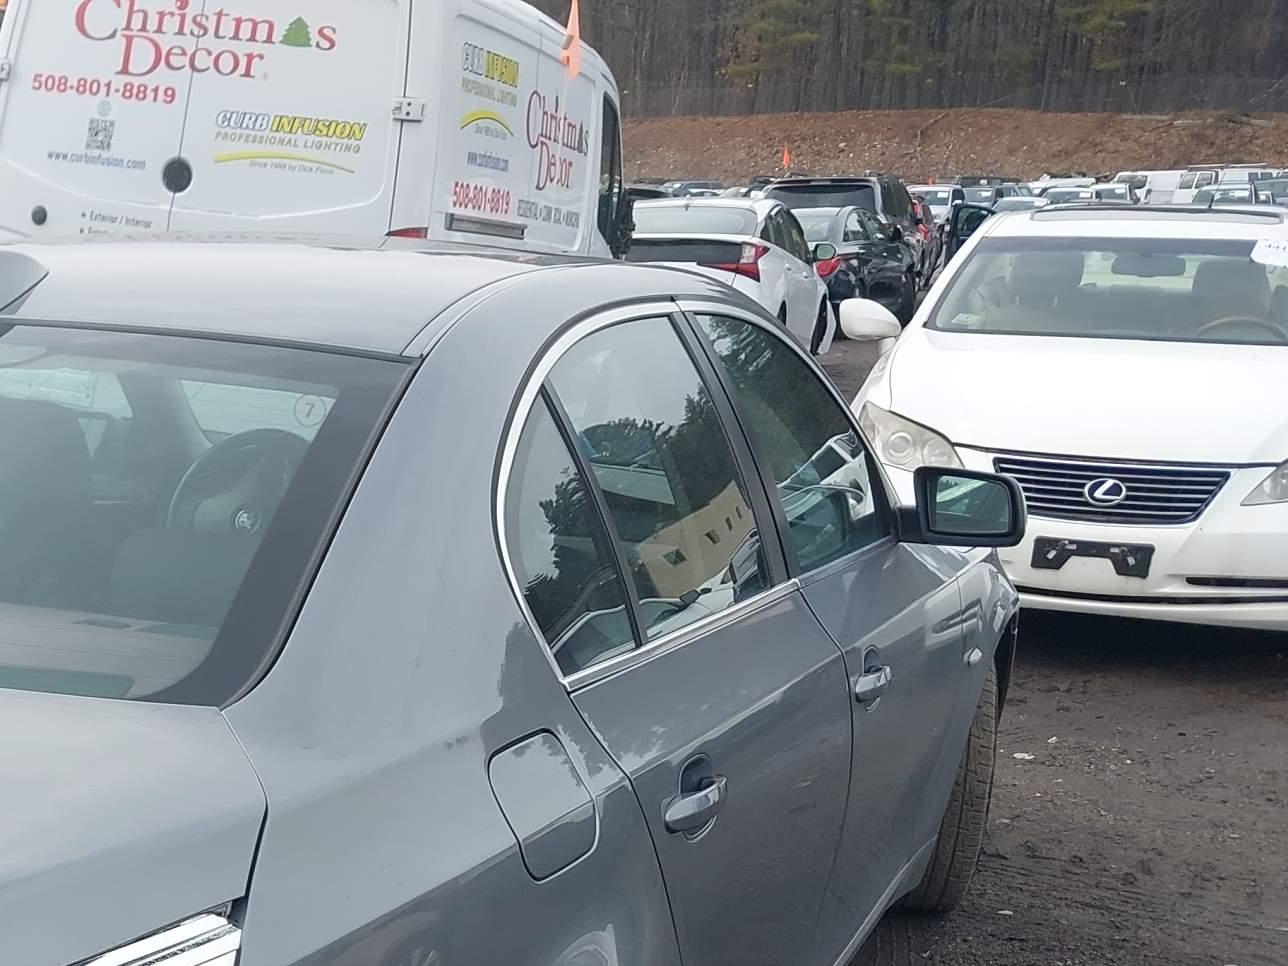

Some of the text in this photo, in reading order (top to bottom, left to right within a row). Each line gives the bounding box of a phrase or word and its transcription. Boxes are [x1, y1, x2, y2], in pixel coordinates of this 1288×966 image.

[115, 34, 265, 78] Decor
[32, 74, 176, 104] 508-801-8819
[215, 110, 368, 141] CURB INFUSION
[214, 131, 361, 154] PROFESSIONAL LIGHTING
[452, 181, 511, 215] 508-801-8819
